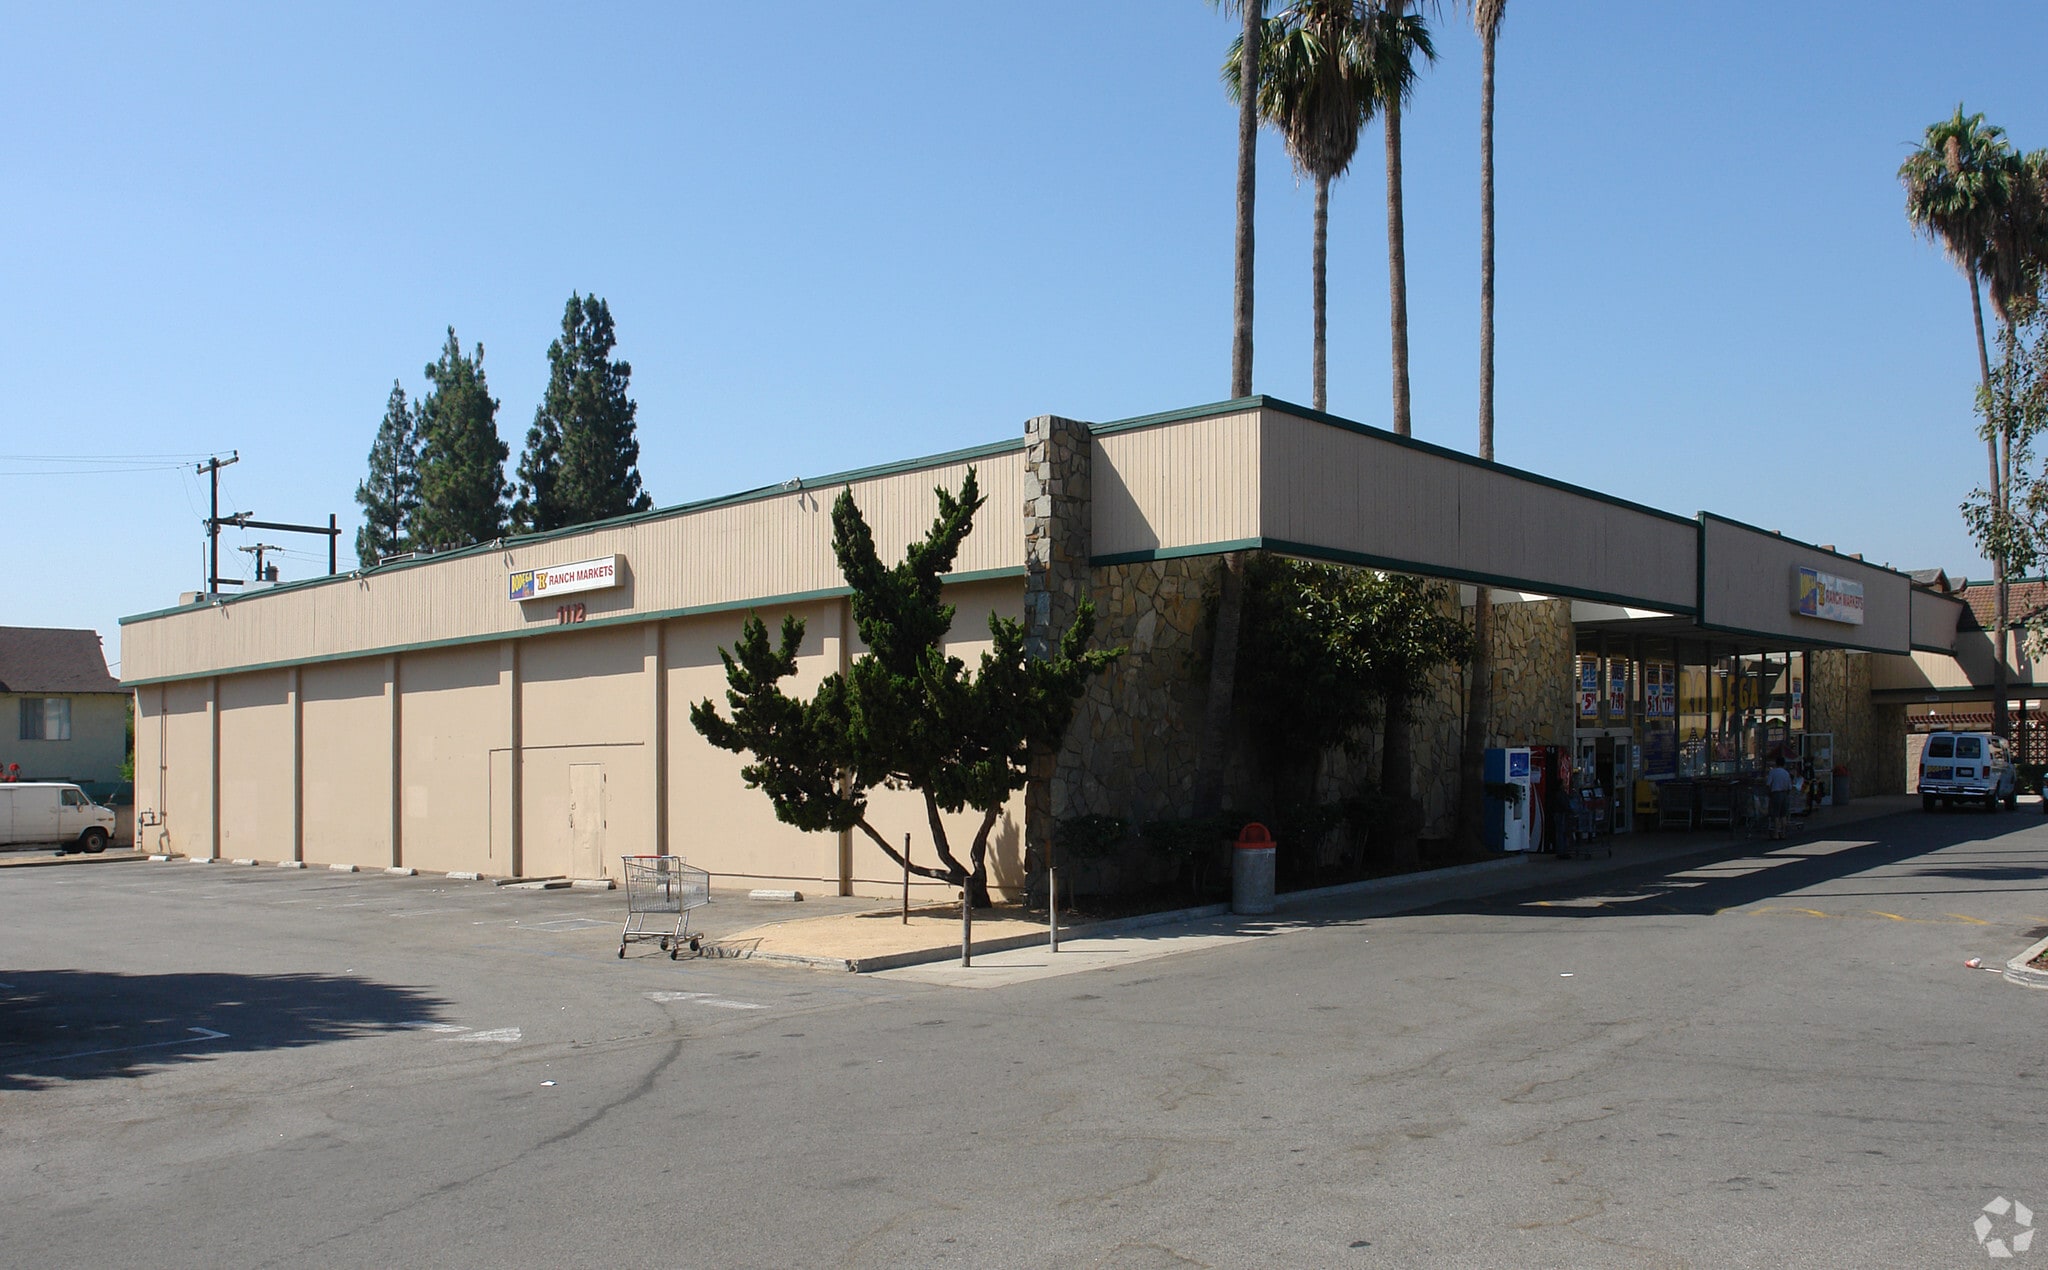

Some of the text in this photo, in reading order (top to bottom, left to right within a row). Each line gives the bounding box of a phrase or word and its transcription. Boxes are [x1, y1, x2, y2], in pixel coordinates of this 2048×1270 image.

[549, 572, 575, 586] RANCH
[577, 565, 613, 580] MARKETS
[557, 603, 586, 625] 1112
